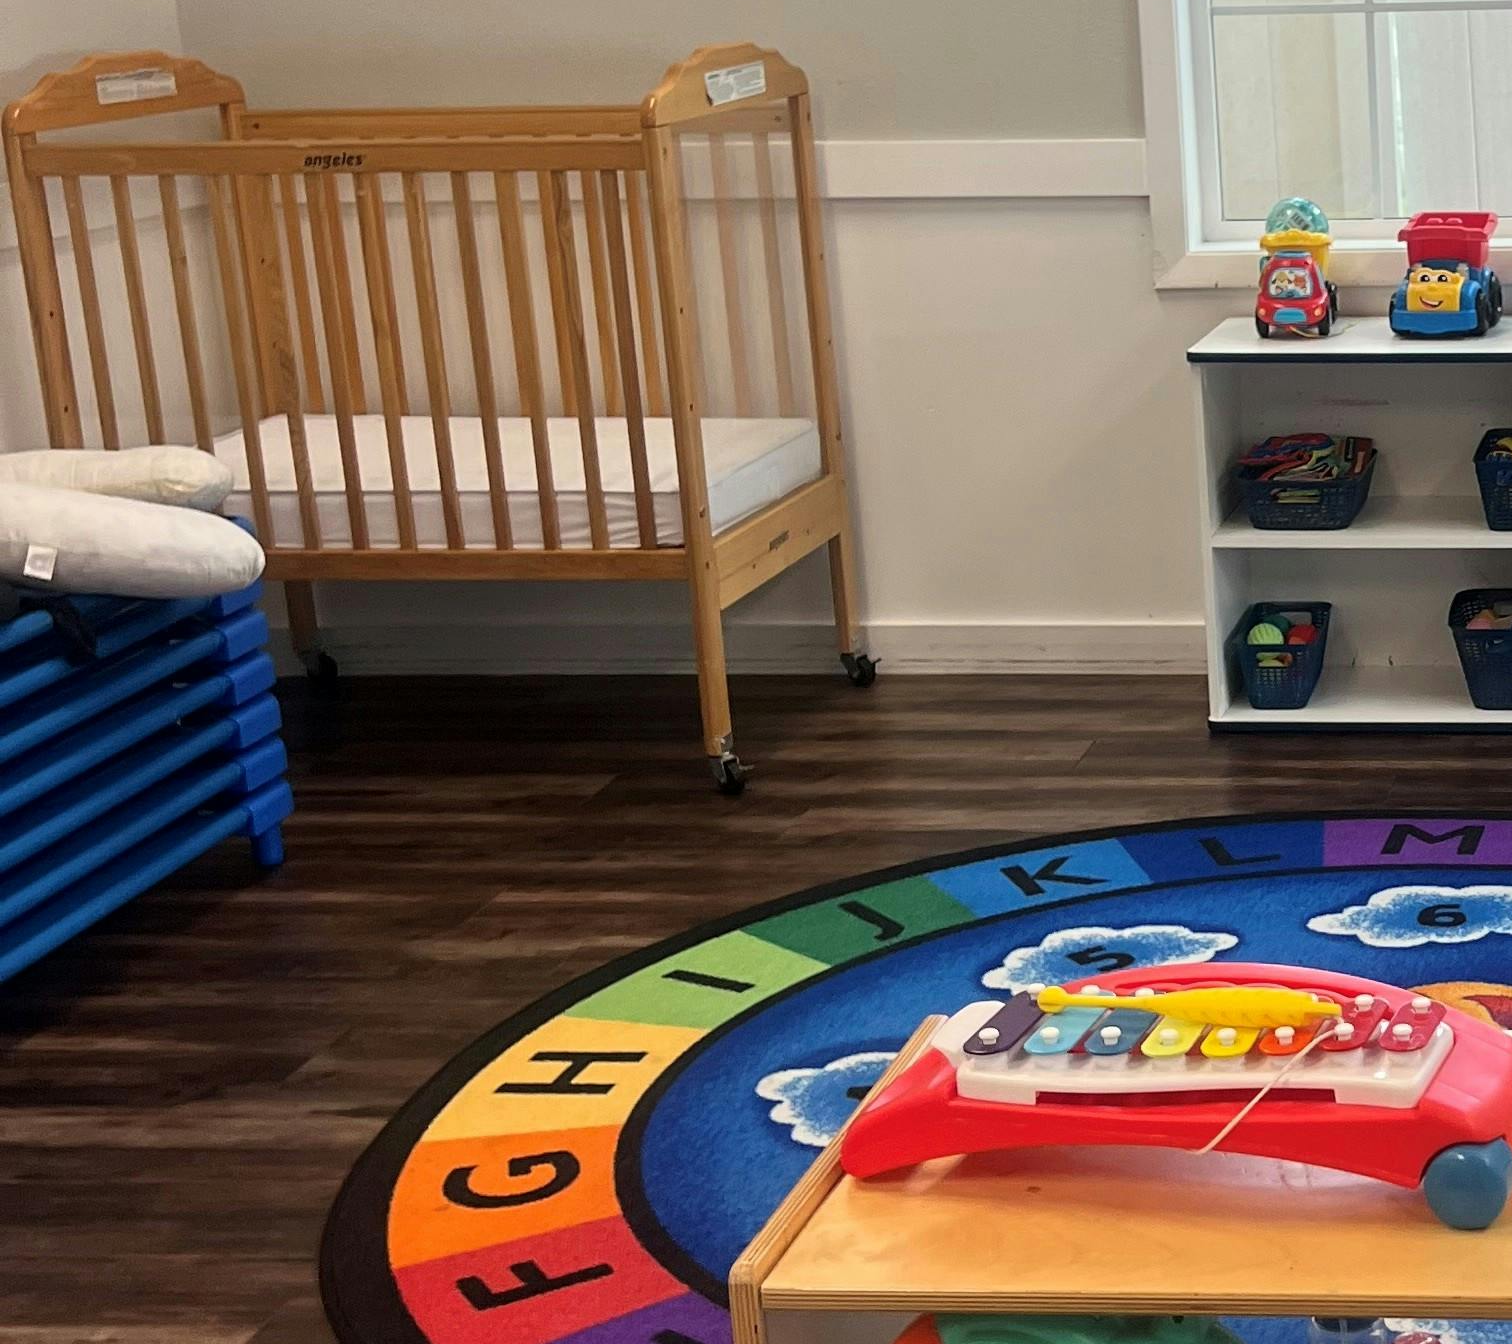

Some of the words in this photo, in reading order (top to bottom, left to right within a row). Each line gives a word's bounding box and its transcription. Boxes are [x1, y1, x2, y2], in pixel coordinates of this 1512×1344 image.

[303, 152, 363, 169] angeles
[1198, 836, 1281, 867] L
[1380, 823, 1486, 856] M
[1001, 856, 1107, 897] K
[838, 900, 905, 942] J
[1416, 903, 1467, 928] 6
[1066, 945, 1137, 973] 5
[663, 969, 755, 994] I
[494, 1050, 648, 1096] H
[442, 1150, 582, 1209] G
[455, 1259, 614, 1312] F
